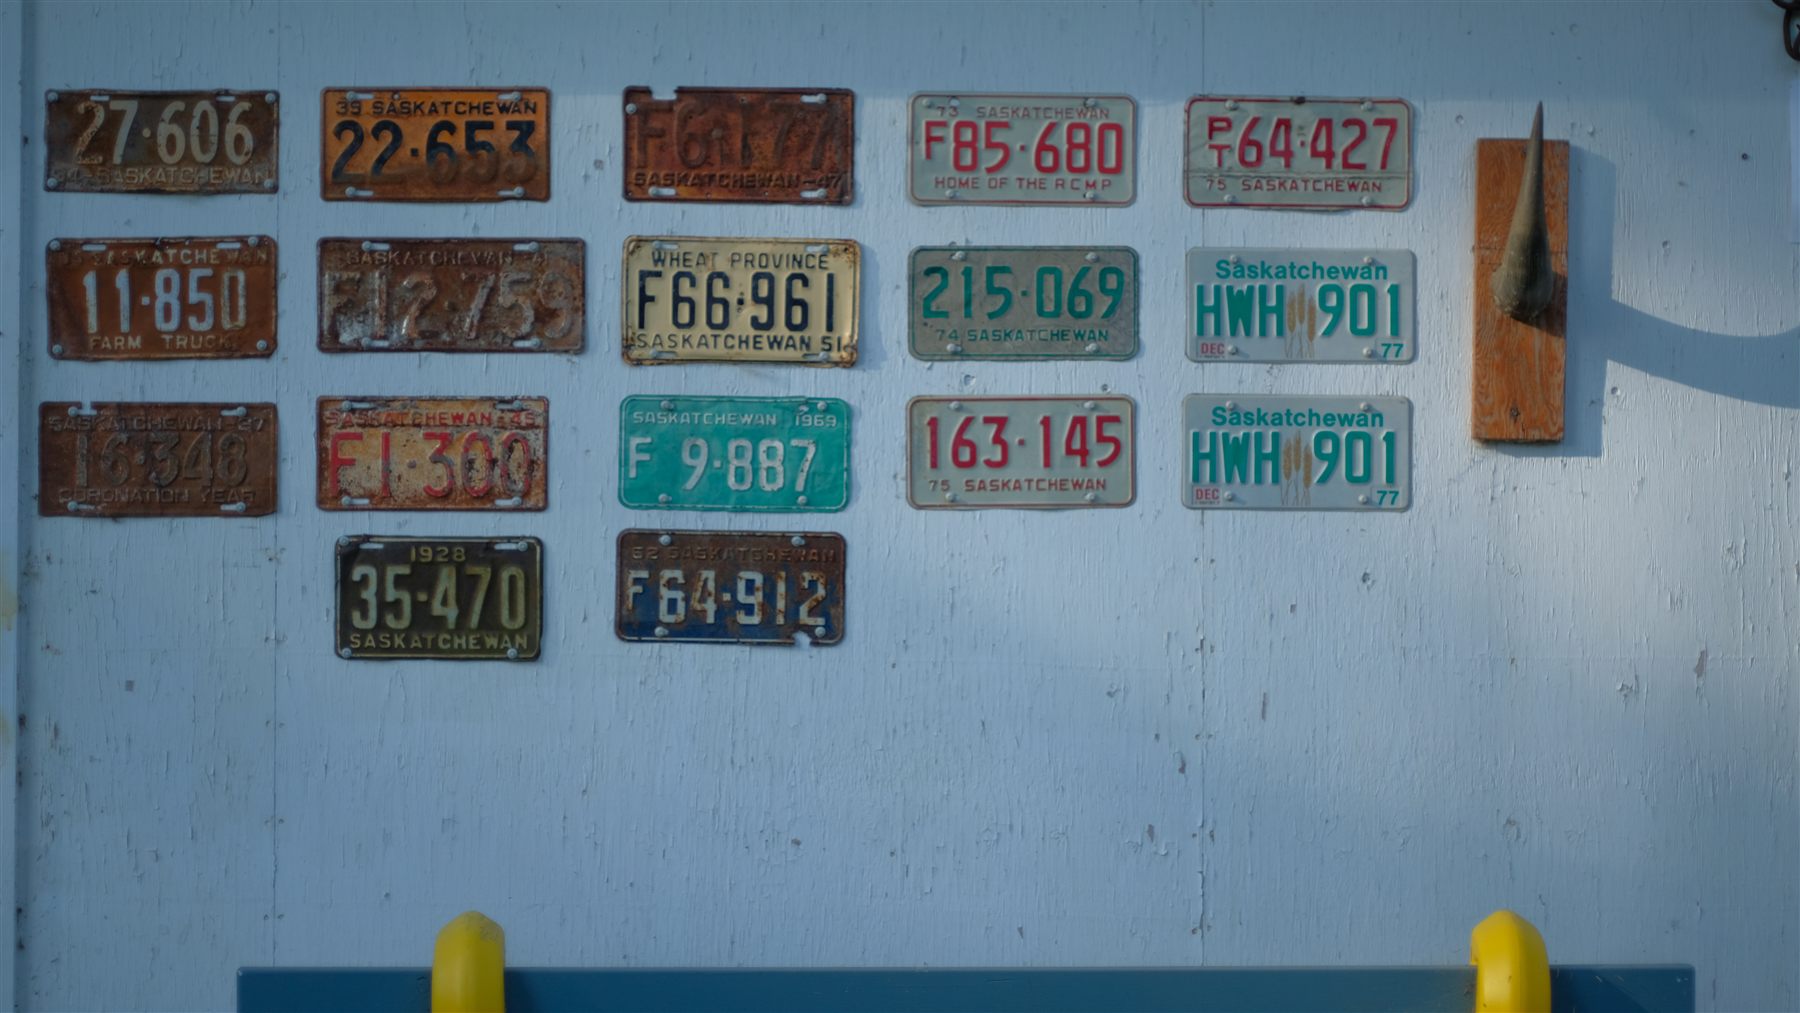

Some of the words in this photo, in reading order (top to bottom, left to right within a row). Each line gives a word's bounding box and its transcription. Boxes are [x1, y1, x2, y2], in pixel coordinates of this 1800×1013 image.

[372, 100, 538, 116] SASKATCHEWAN
[936, 105, 960, 118] 73
[976, 105, 1110, 120] SASKATCHEWAN
[934, 176, 980, 190] HOME
[987, 177, 1009, 190] OF
[1016, 177, 1048, 190] THE
[1241, 179, 1383, 193] SASKATCHEWAN
[652, 251, 719, 269] WHEAT
[730, 252, 830, 271] PROVINCE
[1215, 260, 1388, 281] Saskatchewan
[1195, 283, 1285, 338] HWH
[1317, 282, 1401, 338] 901
[91, 336, 142, 351] FARM
[163, 334, 236, 350] TRUCK
[636, 333, 811, 352] SASKATCHEWAN
[935, 328, 961, 342] 74
[967, 328, 1110, 343] SASKATCHEWAN
[1200, 342, 1226, 356] DEC
[1380, 342, 1405, 359] 77
[632, 410, 778, 426] SASKATCHEWAN
[795, 413, 838, 428] 1969
[1210, 405, 1384, 428] Saskatchewan
[628, 436, 652, 479] F
[1191, 430, 1281, 486] HWH
[1312, 430, 1397, 486] 901
[928, 479, 952, 492] 75
[964, 478, 1107, 493] SASKATCHEWAN
[59, 488, 190, 503] CORONATION
[200, 488, 256, 503] YEAR
[1194, 487, 1220, 501] DEC
[1376, 489, 1400, 506] 77
[410, 546, 467, 563] 1928
[350, 633, 529, 650] SASKATCHEWAN
